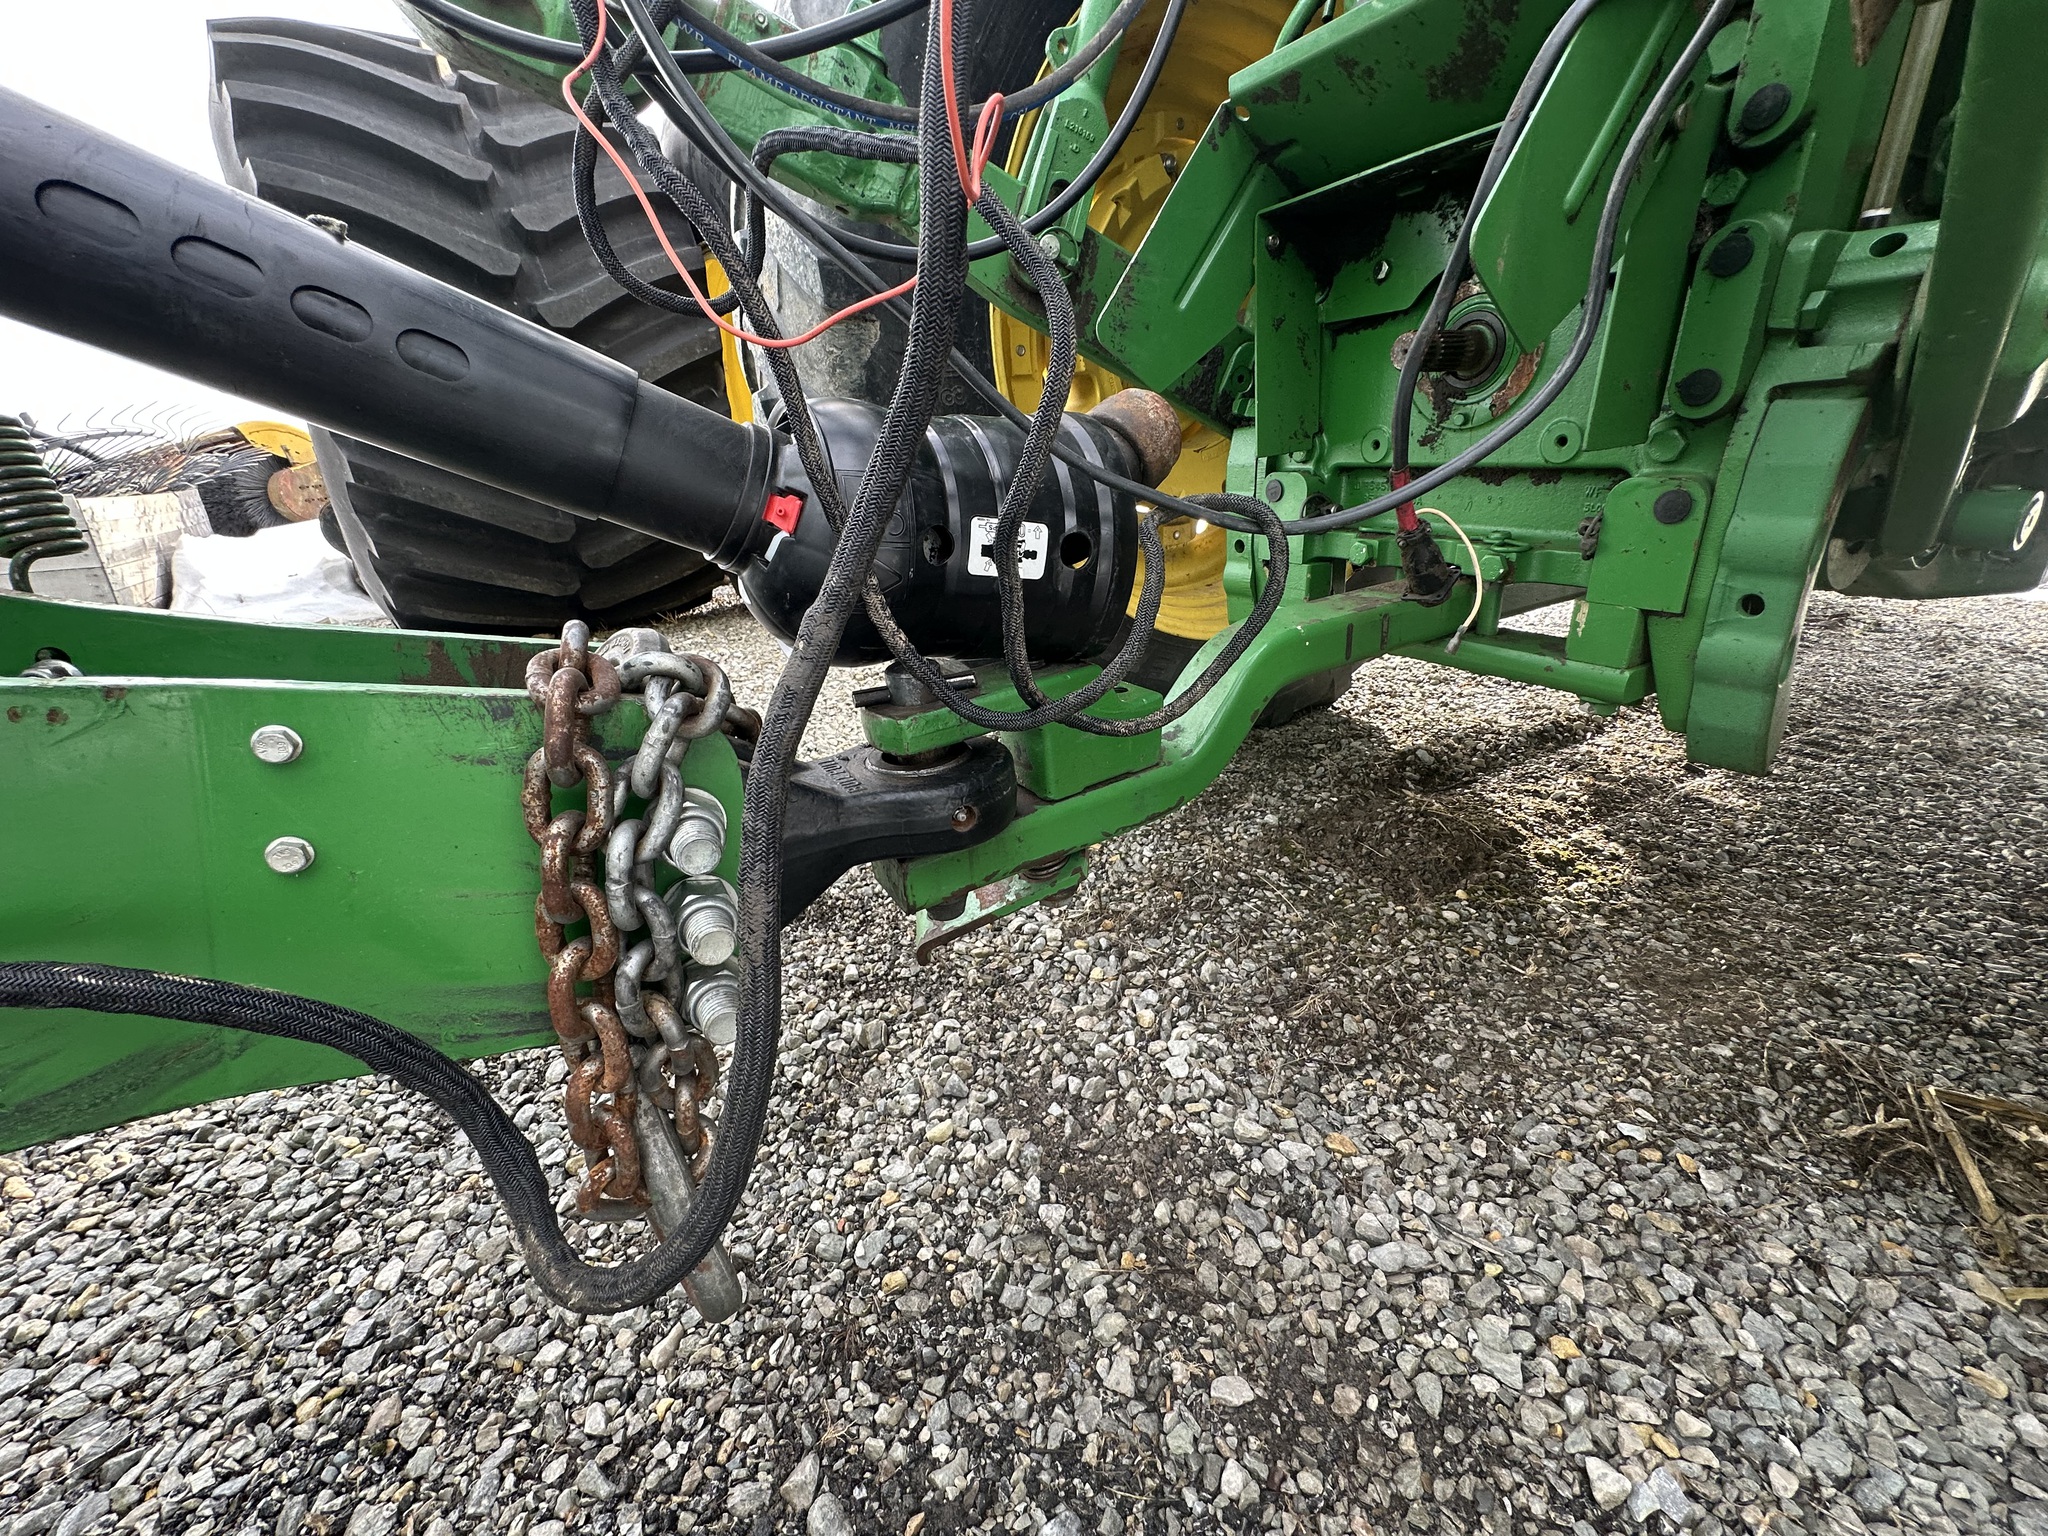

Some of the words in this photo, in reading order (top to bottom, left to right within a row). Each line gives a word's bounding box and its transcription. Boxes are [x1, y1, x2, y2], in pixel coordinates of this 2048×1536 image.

[676, 17, 704, 42] WP
[727, 52, 785, 90] FLAME
[789, 84, 877, 127] RESISTANT
